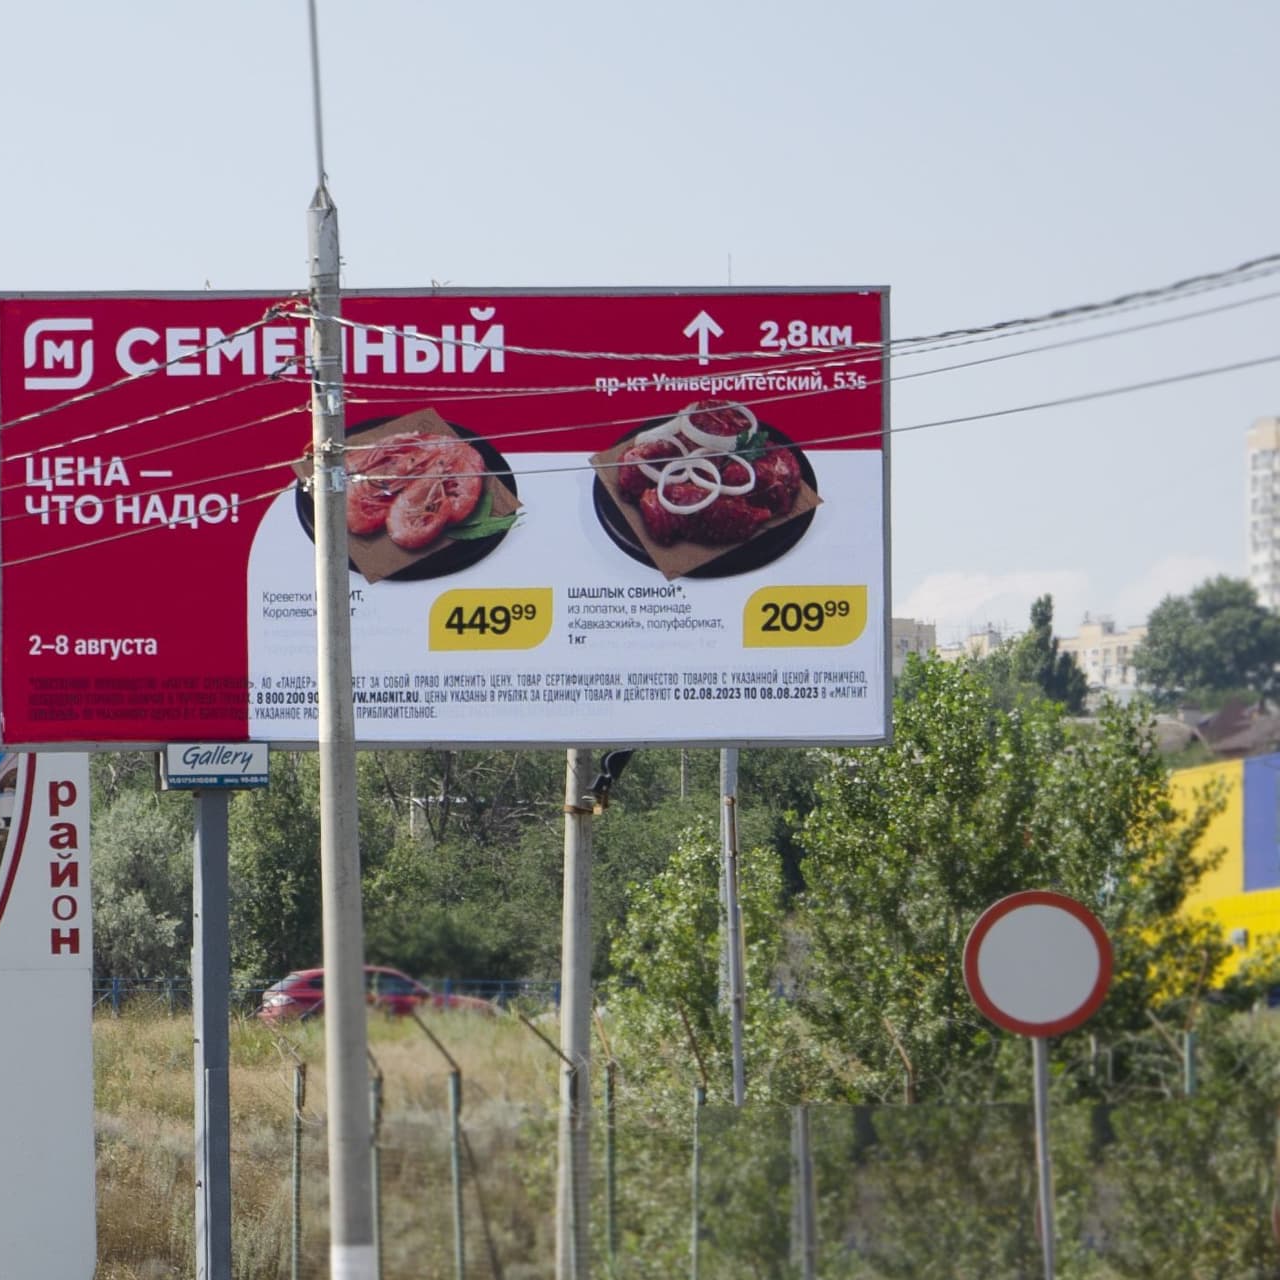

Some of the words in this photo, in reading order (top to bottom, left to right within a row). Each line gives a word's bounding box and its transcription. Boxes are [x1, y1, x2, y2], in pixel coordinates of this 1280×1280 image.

[115, 307, 505, 377] СЕМЕНЫЙ
[595, 376, 647, 395] пр-кт
[652, 370, 828, 395] Университетский,
[25, 457, 130, 491] ЦЕНА
[25, 495, 104, 525] ЧТО
[115, 493, 239, 529] НАДО!
[262, 591, 312, 604] Креветки
[568, 586, 625, 599] ШАШЛЫК
[262, 606, 317, 618] Королевск
[568, 604, 580, 614] из
[583, 604, 628, 616] лопатки,
[630, 604, 637, 614] в
[640, 603, 691, 614] маринаде
[568, 617, 644, 630] «Кавказский»,
[647, 617, 724, 631] полуфабрикат,
[74, 637, 158, 661] августа
[276, 675, 316, 689] «ТАНДЕР»
[370, 676, 380, 688] ЗА
[384, 673, 410, 688] СОБОЙ
[414, 675, 440, 688] ПРАВО
[443, 674, 486, 688] ИЗМЕНИТЬ
[490, 674, 513, 689] ЦЕНУ.
[517, 674, 541, 687] ТОВАР
[545, 673, 623, 688] СЕРТИФИЦИРОВАН.
[627, 672, 679, 686] КОЛИЧЕСТВО
[683, 672, 718, 685] ТОВАРОВ
[731, 669, 778, 684] УКАЗАННОЙ
[782, 669, 810, 686] ЦЕНОЙ
[265, 692, 284, 704] 800
[286, 692, 305, 704] 200
[352, 691, 420, 704] W.MAGNIT.RU.
[424, 690, 447, 705] ЦЕНЫ
[450, 689, 487, 702] УКАЗАНЫ
[498, 689, 527, 701] РУБЛЯХ
[530, 688, 540, 701] ЗА
[543, 688, 581, 702] ЕДИНИЦУ
[584, 688, 613, 701] ТОВАРА
[624, 686, 672, 702] ДЕЙСТВУЮТ
[683, 687, 740, 700] 02.08.2023
[744, 687, 757, 700] ПО
[760, 687, 818, 699] 08.08.2023
[829, 686, 868, 698] «МАГНИТ
[255, 707, 301, 719] УКАЗАННОЕ
[356, 706, 438, 719] ПРИБЛИЗИТЕЛЬНОЕ.
[182, 746, 254, 773] Gallery
[48, 780, 80, 955] район
